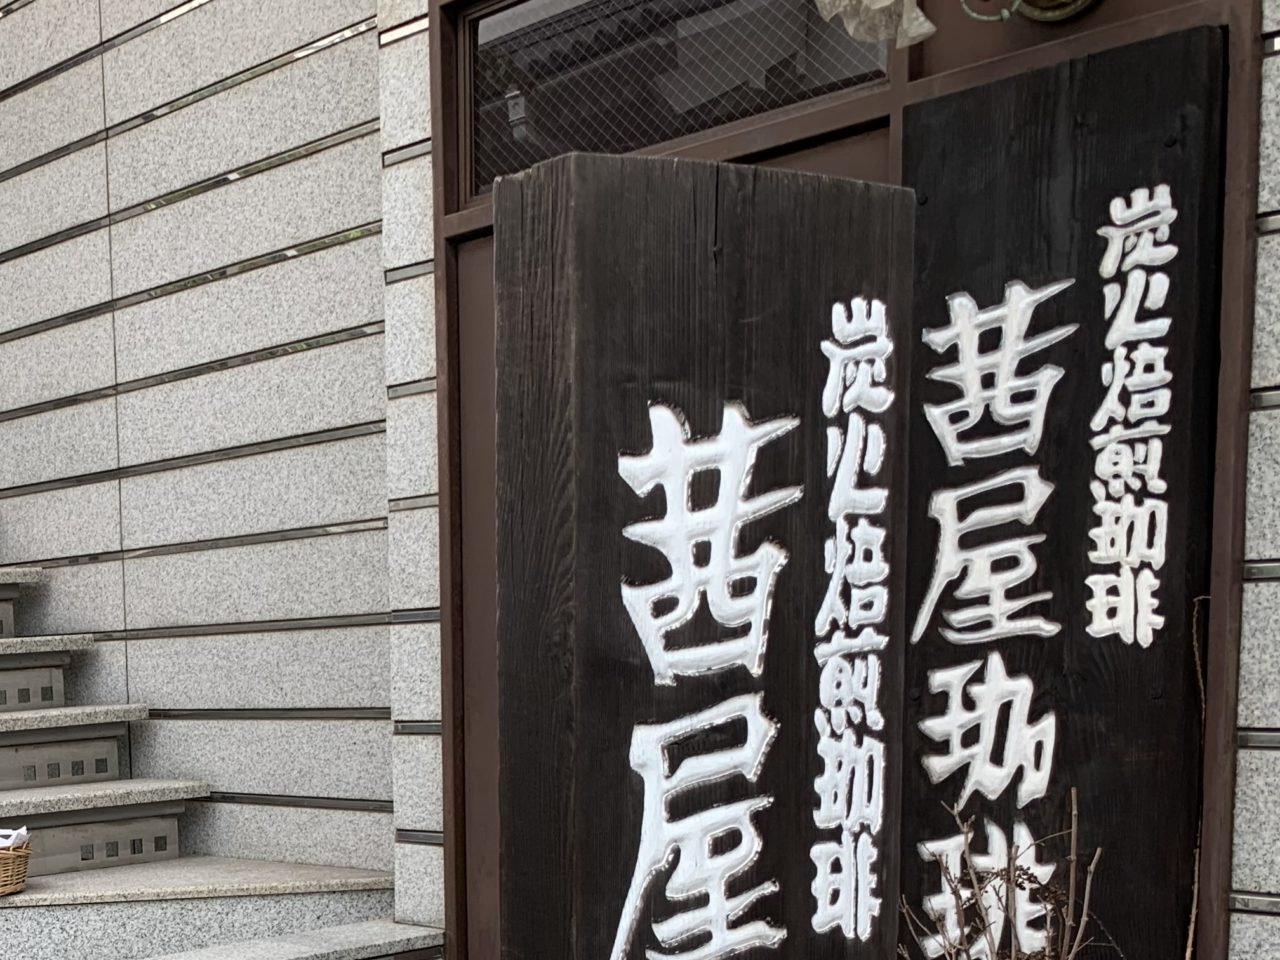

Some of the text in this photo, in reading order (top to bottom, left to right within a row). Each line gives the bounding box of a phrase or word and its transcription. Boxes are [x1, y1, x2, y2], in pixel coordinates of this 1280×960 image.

[811, 295, 895, 942] 炭火焙煎珈琲
[1086, 184, 1180, 648] 炭火焙煎珈琲
